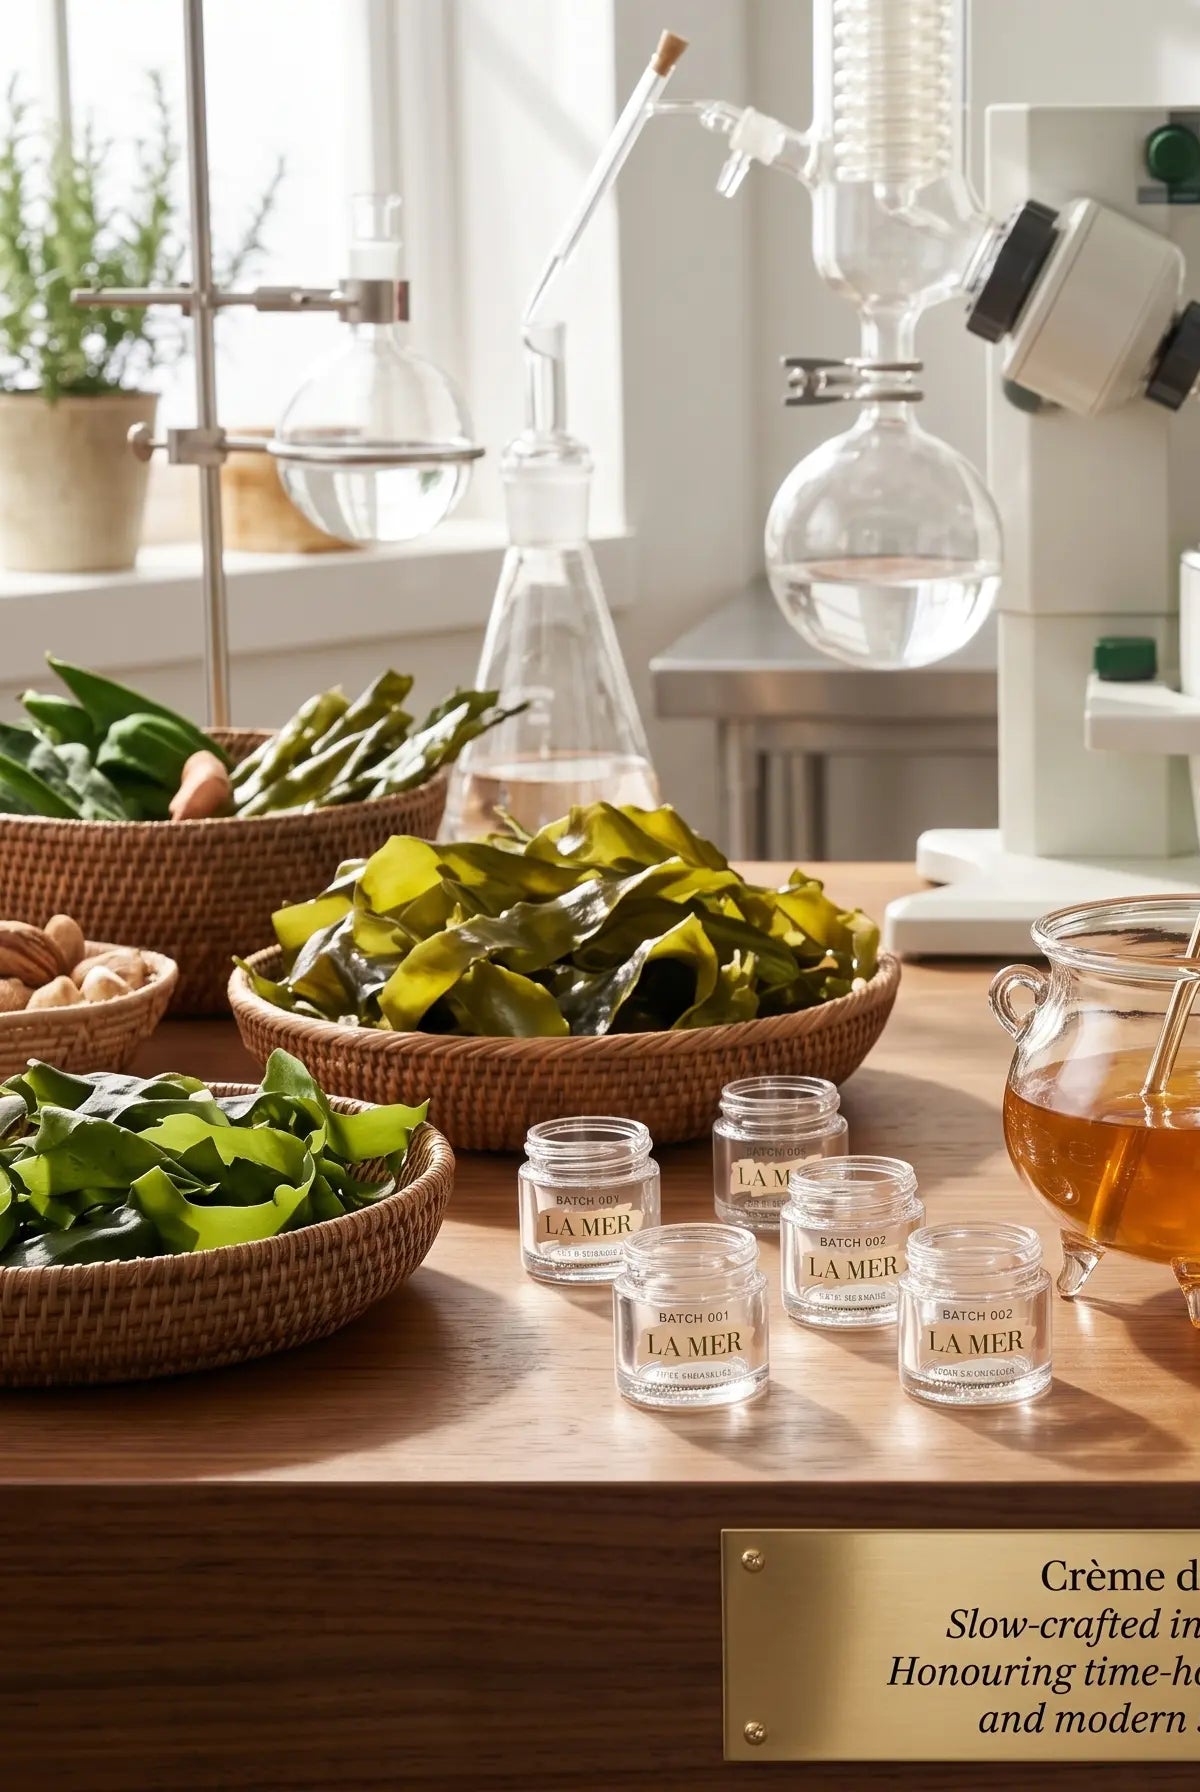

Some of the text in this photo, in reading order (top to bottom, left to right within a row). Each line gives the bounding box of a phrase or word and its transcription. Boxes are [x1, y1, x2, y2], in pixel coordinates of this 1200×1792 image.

[738, 1166, 767, 1188] LA
[556, 1195, 594, 1206] BATCH
[545, 1214, 633, 1237] LA MER
[820, 1235, 887, 1248] BATCH 002
[808, 1255, 900, 1280] LA MER
[659, 1310, 729, 1324] BATCH 001
[943, 1308, 1014, 1321] BATCH 002
[646, 1331, 743, 1357] LA MER
[928, 1329, 1025, 1355] LA MER
[1041, 1558, 1165, 1592] Crème
[946, 1607, 1162, 1648] Slow-crafted
[886, 1656, 1077, 1695] Honouring
[978, 1701, 1047, 1735] and
[1055, 1701, 1187, 1735] modern
